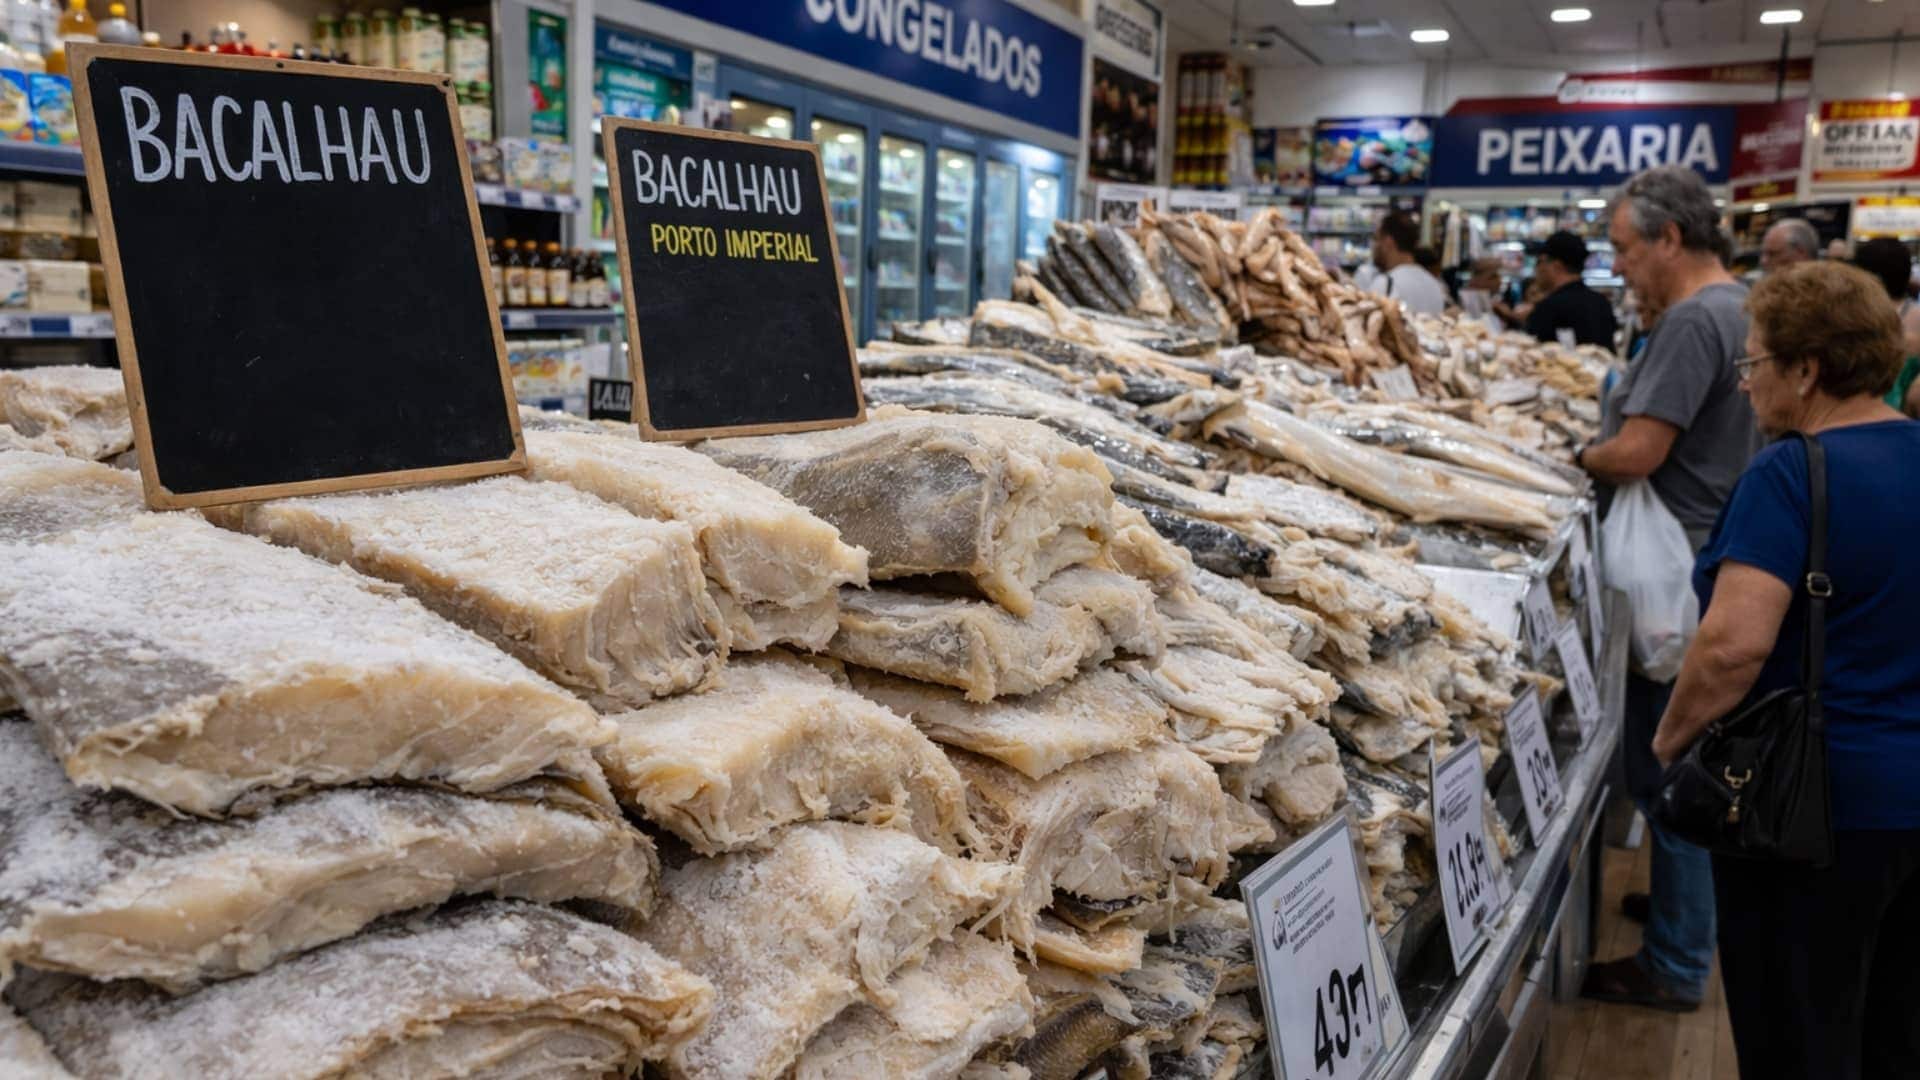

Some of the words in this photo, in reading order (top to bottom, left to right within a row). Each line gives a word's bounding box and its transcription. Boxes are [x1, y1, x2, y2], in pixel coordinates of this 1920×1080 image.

[120, 86, 431, 184] BACALHAU
[1477, 123, 1718, 175] PEIXARIA
[632, 149, 801, 215] BACALHAU
[651, 223, 717, 257] PORTO
[725, 228, 819, 263] IMPERIAL
